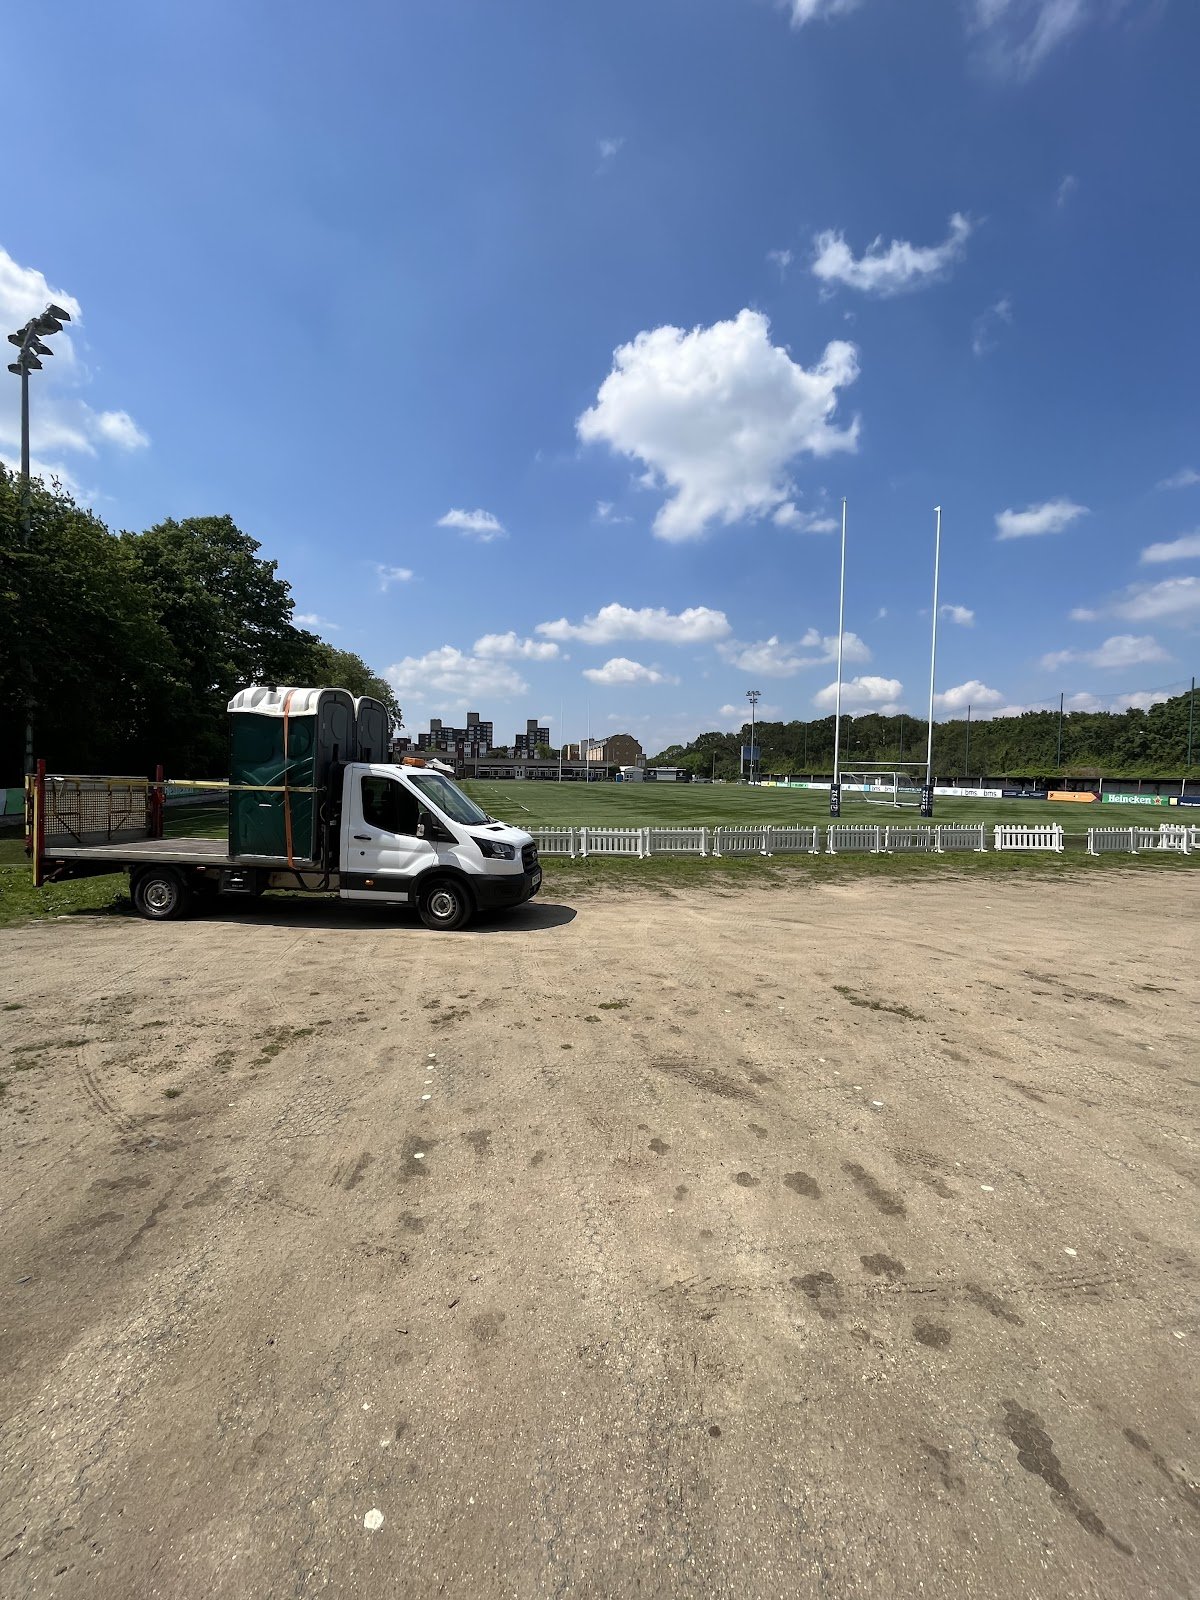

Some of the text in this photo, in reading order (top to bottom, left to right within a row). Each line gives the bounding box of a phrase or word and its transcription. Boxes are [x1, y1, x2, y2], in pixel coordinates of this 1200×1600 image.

[964, 788, 978, 796] bms
[983, 789, 997, 797] bms
[1108, 794, 1151, 804] Heineken
